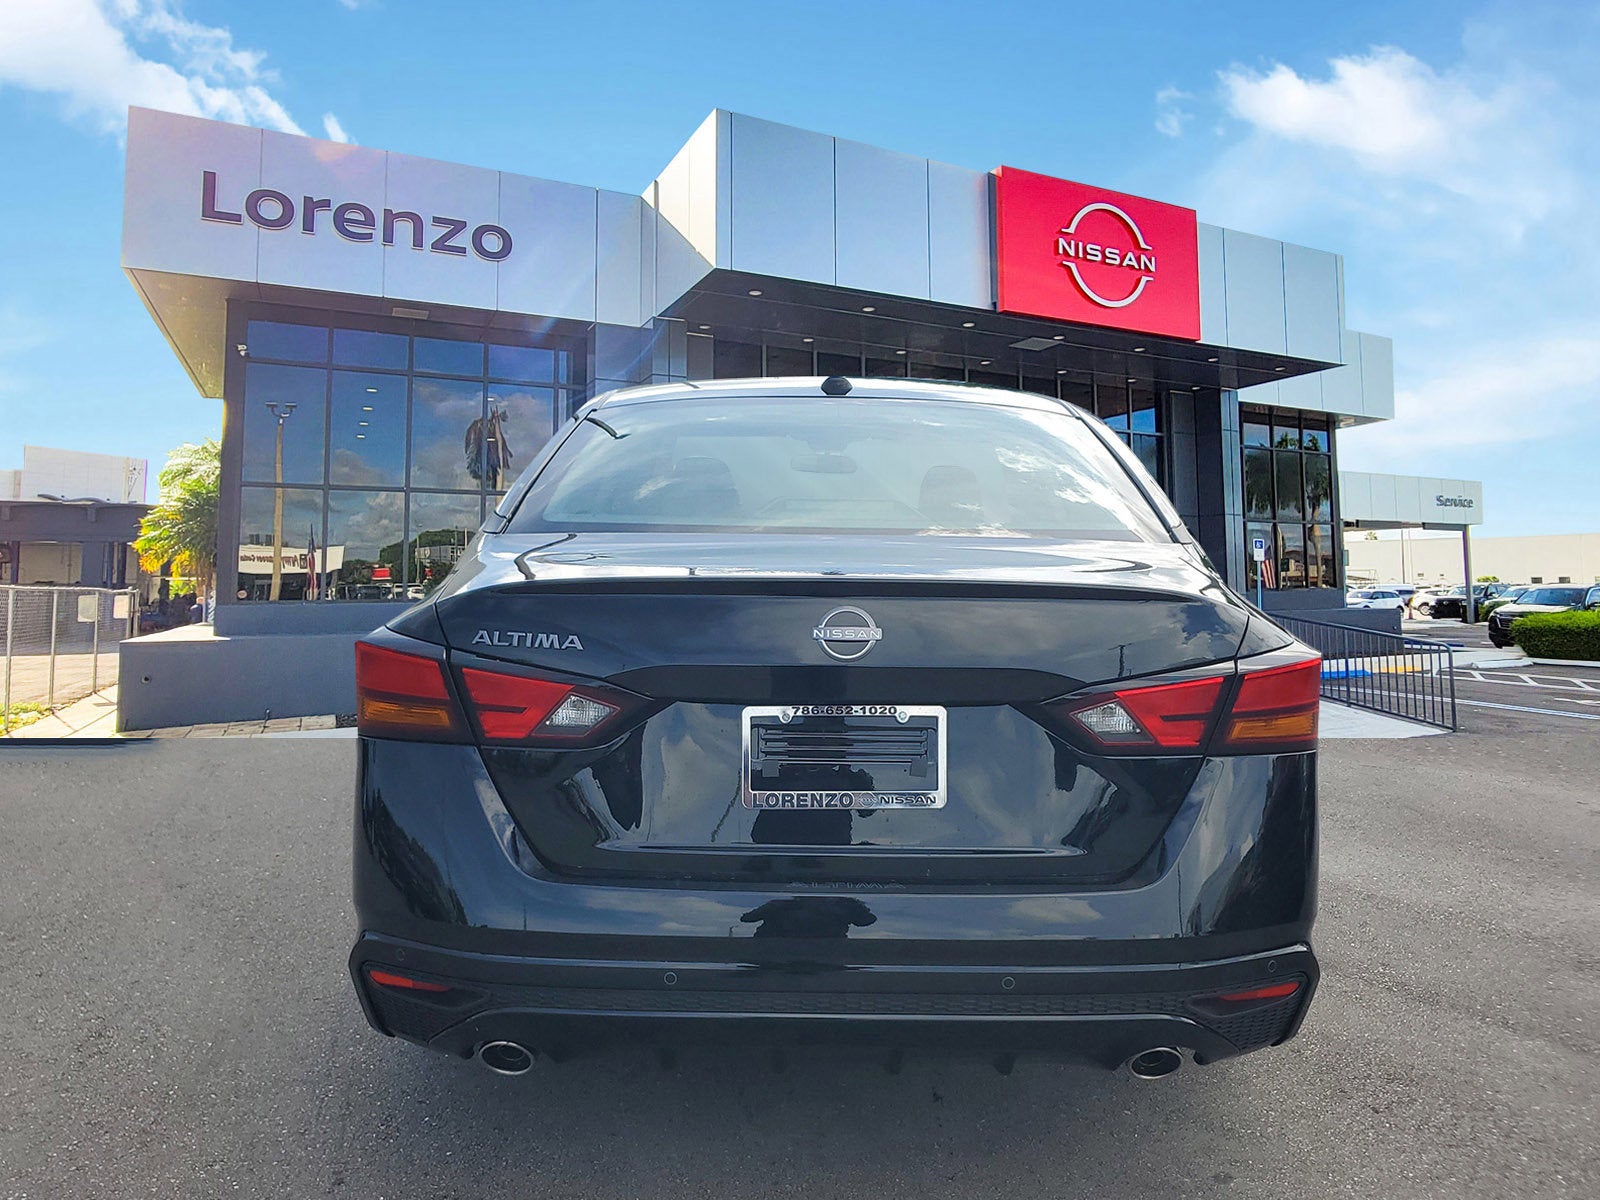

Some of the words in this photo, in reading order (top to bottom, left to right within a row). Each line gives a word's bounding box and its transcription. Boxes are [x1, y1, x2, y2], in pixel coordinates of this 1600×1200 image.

[201, 170, 513, 262] Lorenzo
[1058, 237, 1156, 273] NISSAN
[1435, 494, 1474, 508] Service
[471, 629, 584, 651] ALTIMA
[813, 628, 881, 639] NISSAN
[791, 706, 897, 715] 786-652-1020
[752, 791, 854, 809] LORENZO
[880, 795, 937, 804] NISSAN
